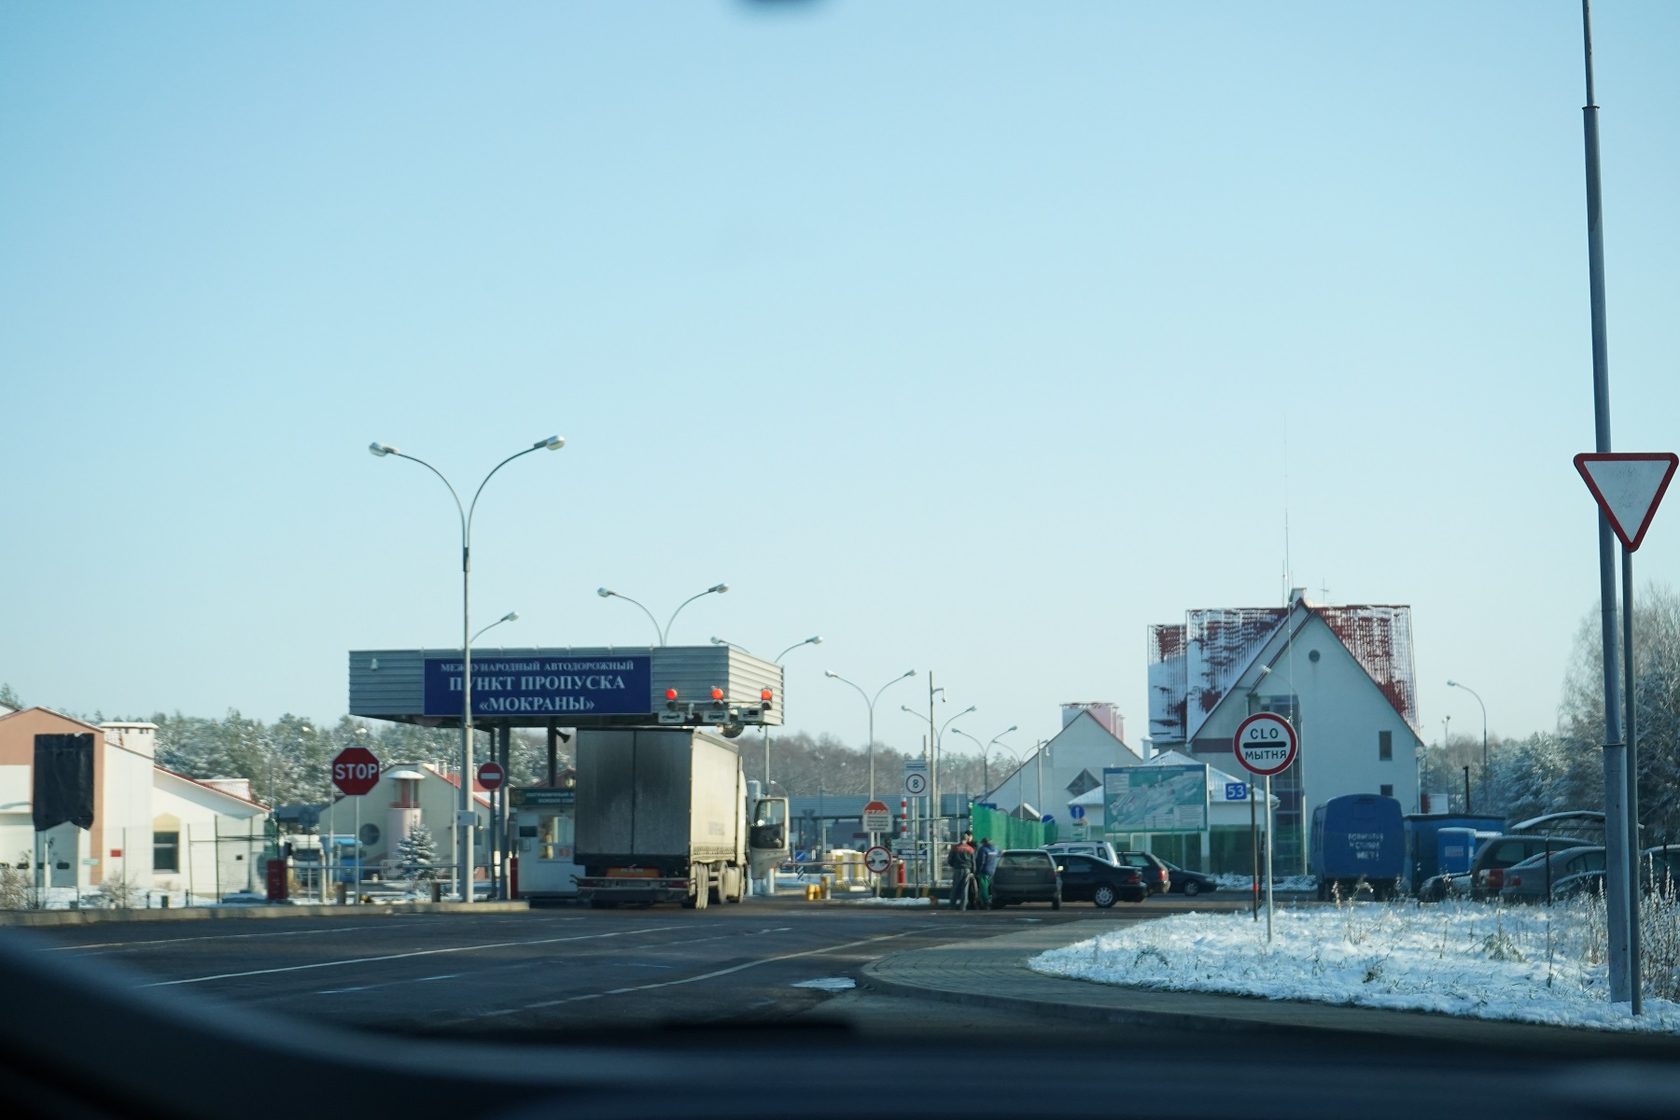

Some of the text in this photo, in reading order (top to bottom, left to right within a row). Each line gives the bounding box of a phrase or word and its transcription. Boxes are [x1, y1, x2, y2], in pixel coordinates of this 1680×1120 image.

[544, 660, 634, 671] АВТОДОРОЖНЫЙ
[521, 675, 625, 690] ПРОПУСКА
[480, 696, 595, 711] «МОКРАНЫ»
[1250, 728, 1279, 739] CLO
[1245, 750, 1286, 760] МЫТНЯ
[335, 763, 378, 780] STOP
[912, 779, 920, 789] 8
[1227, 785, 1244, 798] 53
